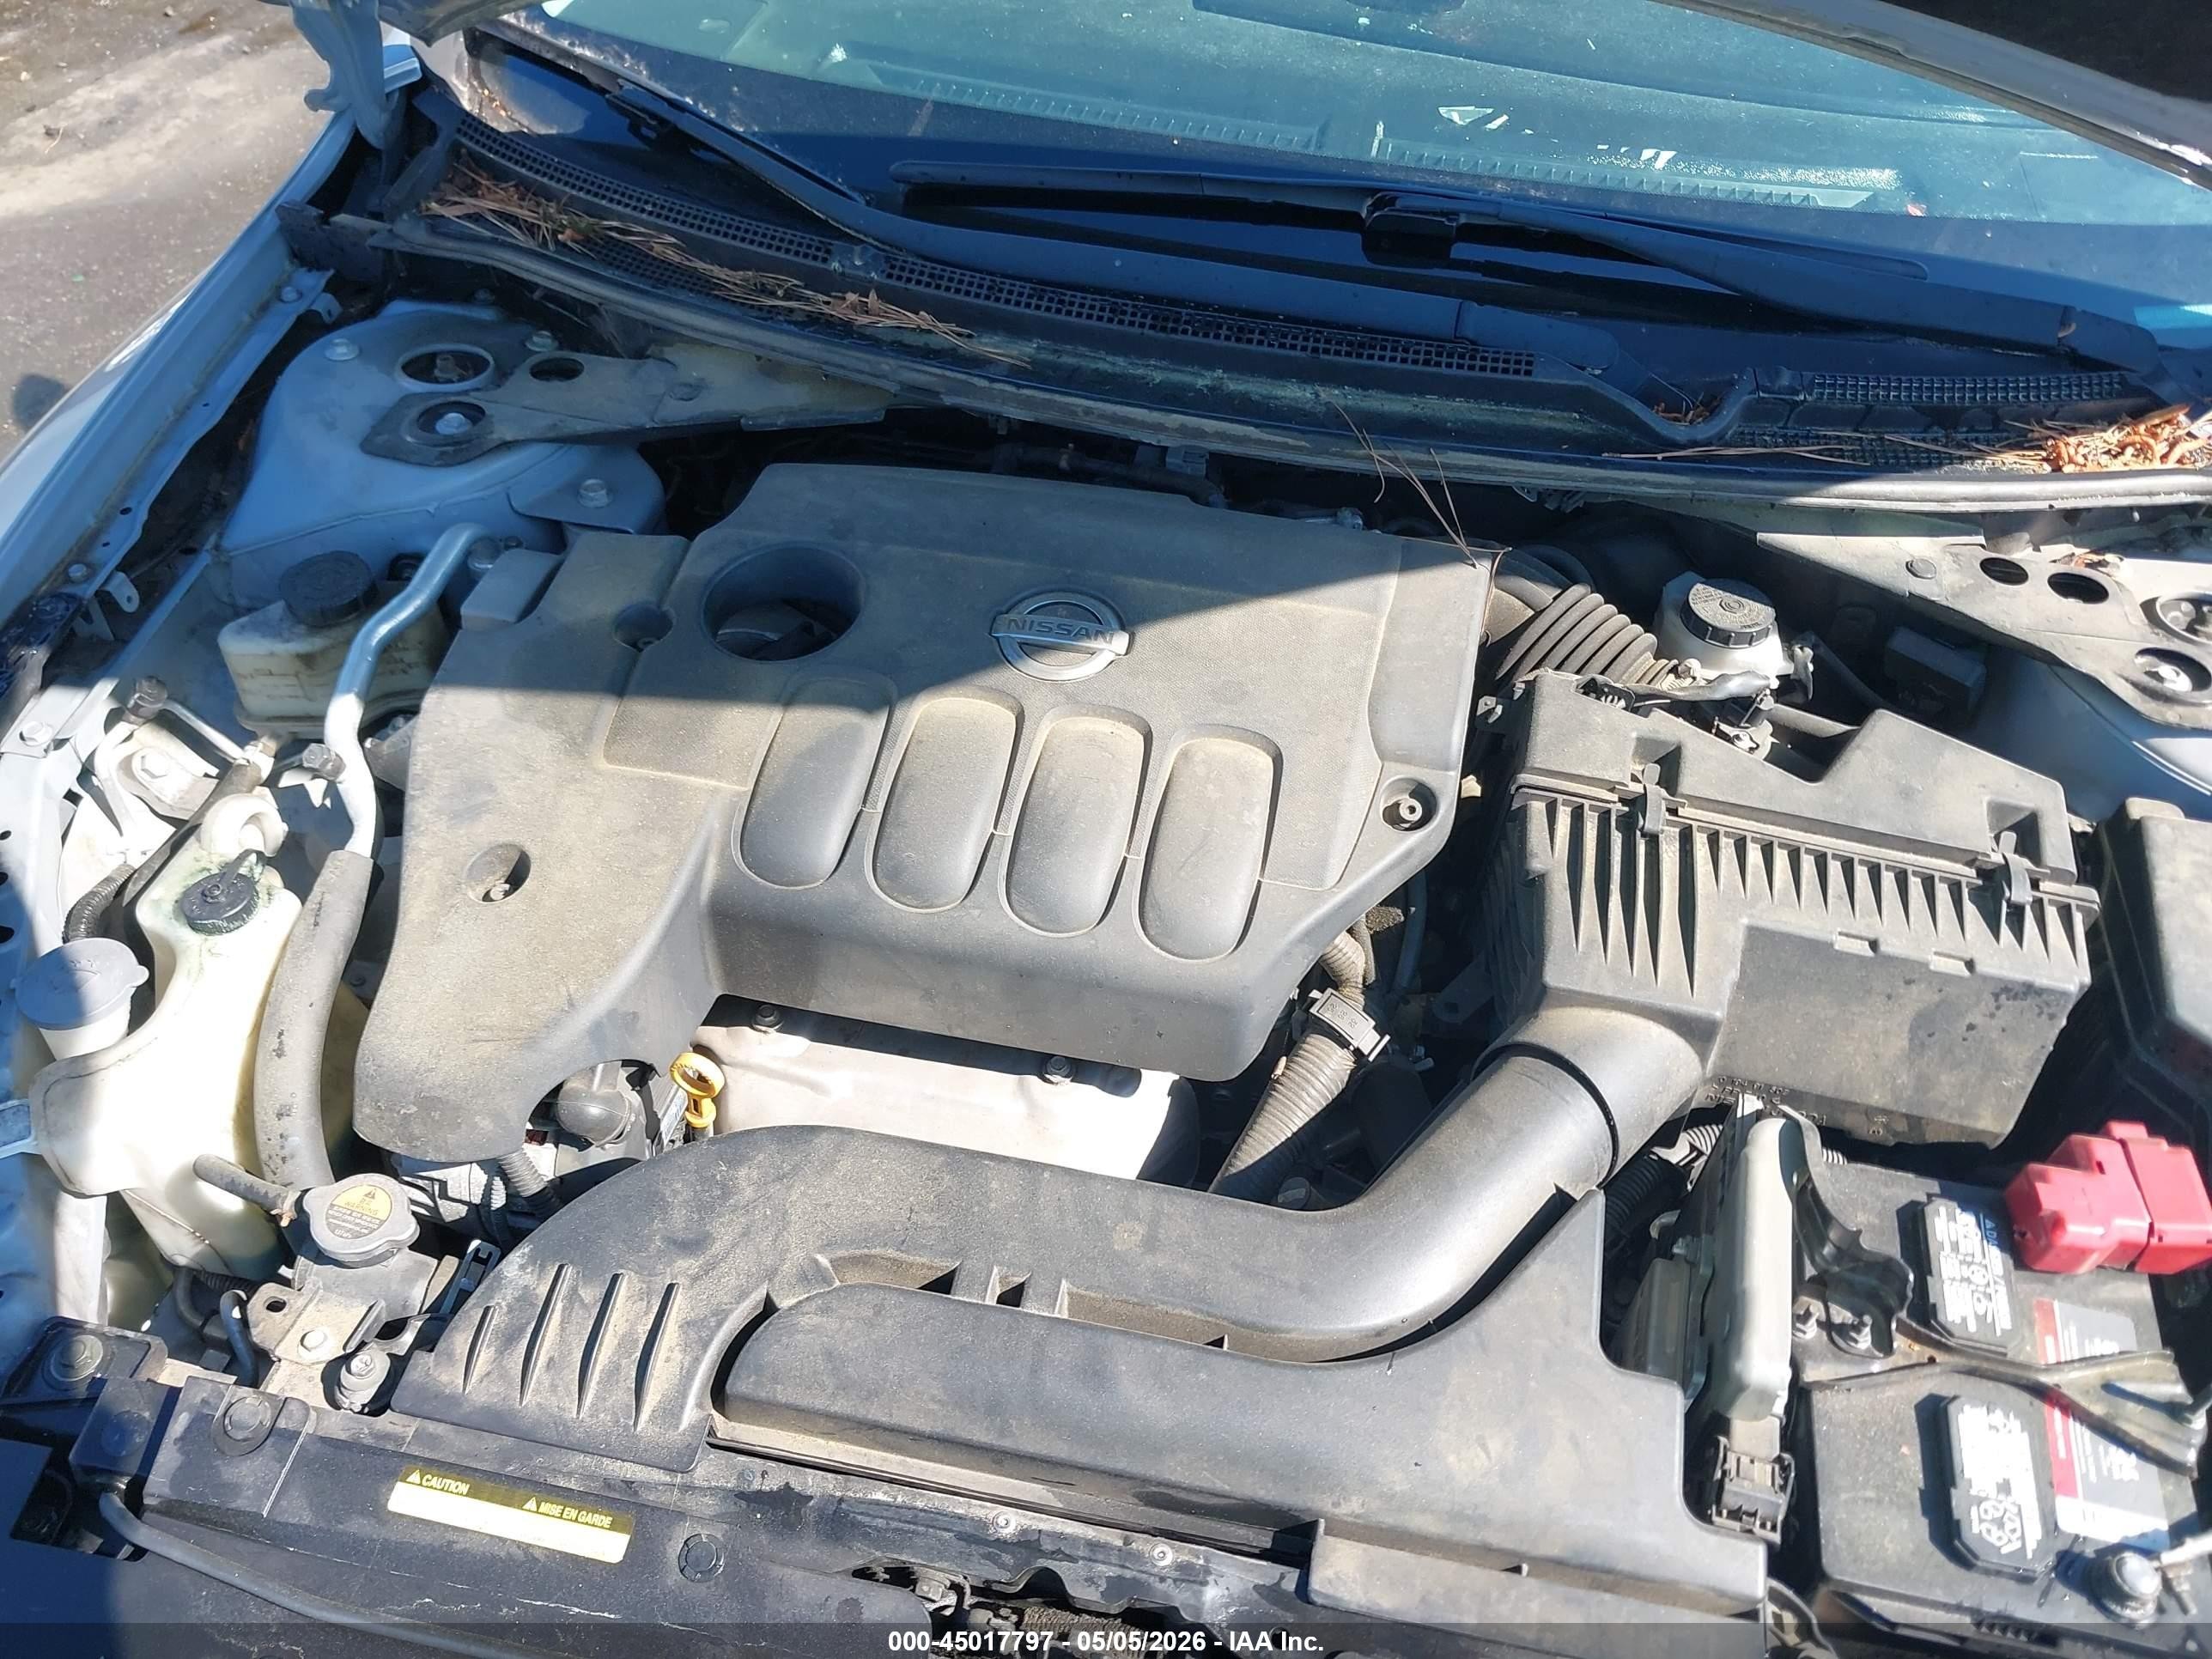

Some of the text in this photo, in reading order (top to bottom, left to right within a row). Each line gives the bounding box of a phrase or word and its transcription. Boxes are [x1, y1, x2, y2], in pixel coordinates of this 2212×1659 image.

[1006, 617, 1114, 645] NISSAN
[421, 1474, 471, 1496] CAUTION
[538, 1501, 613, 1528] MISE EN GARDE
